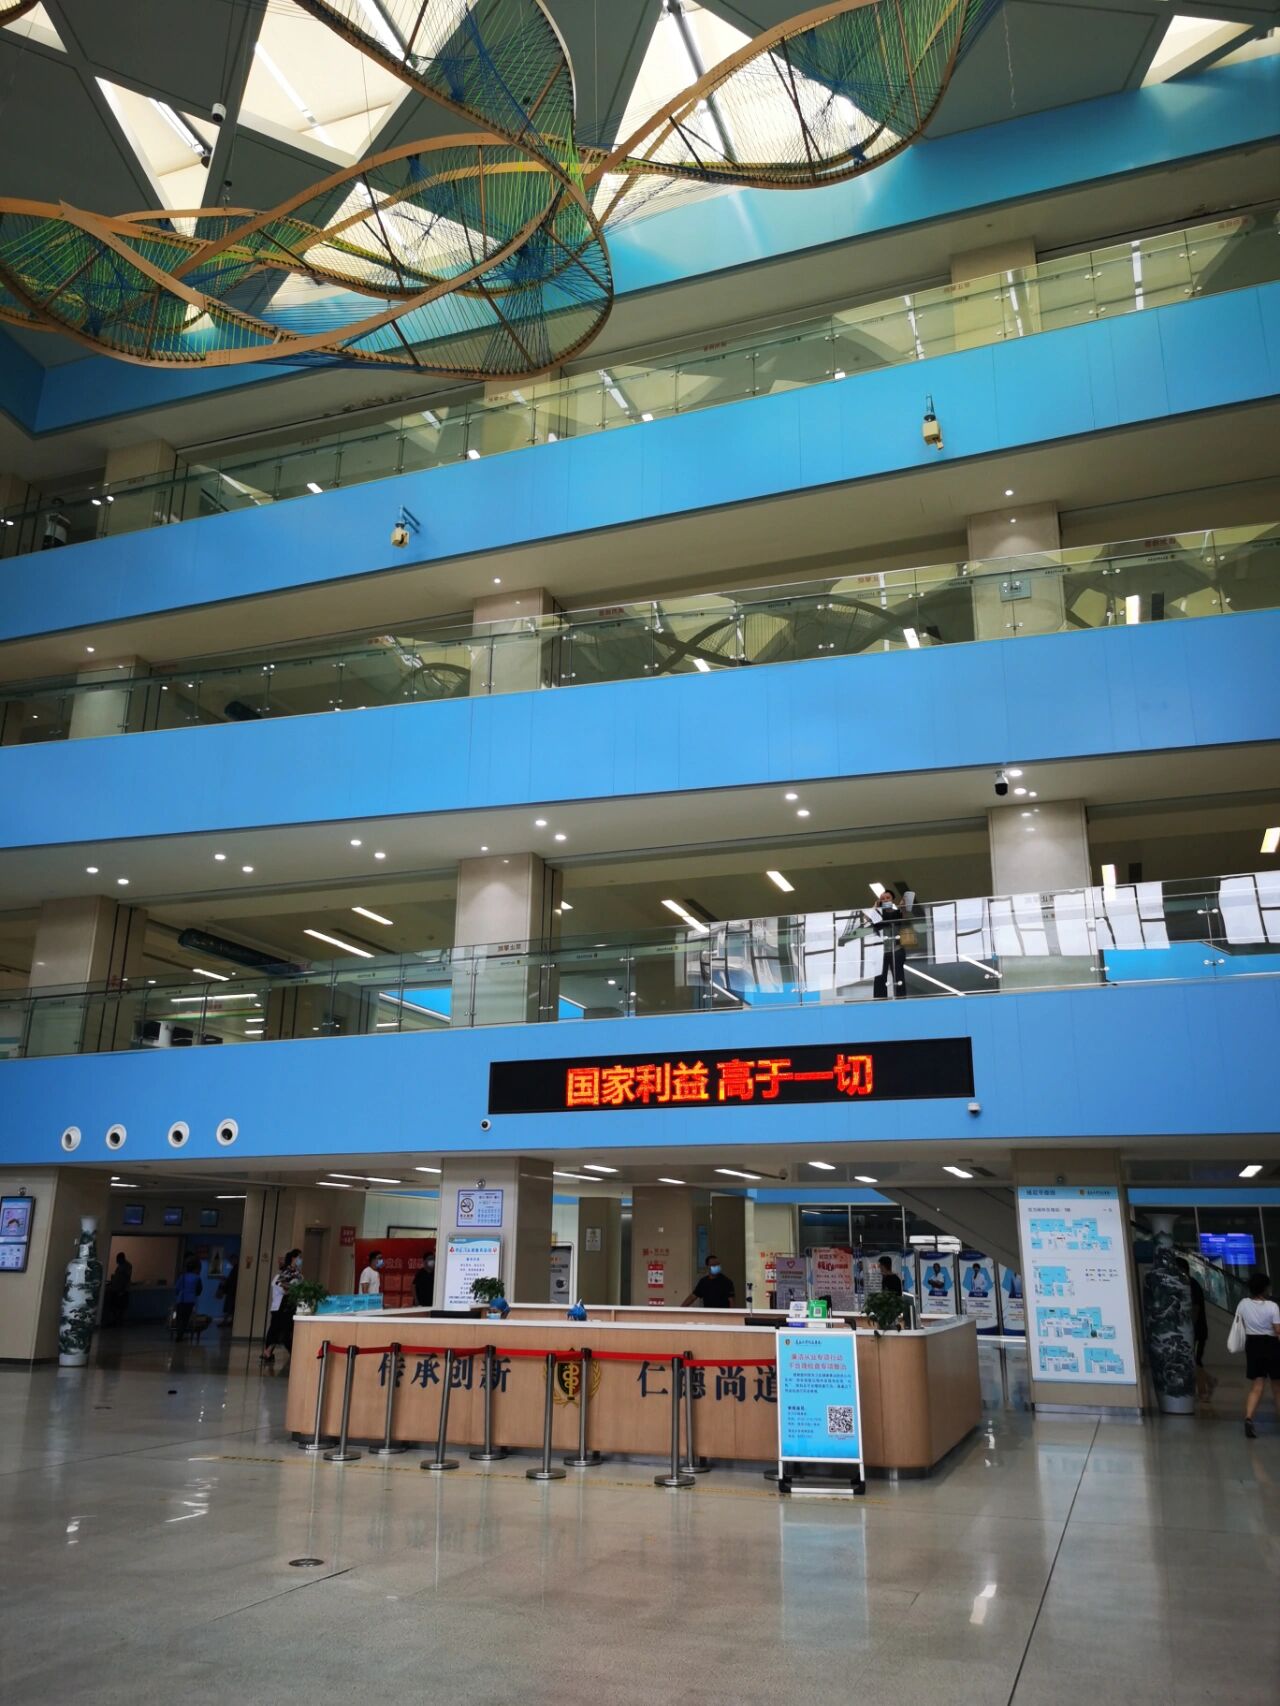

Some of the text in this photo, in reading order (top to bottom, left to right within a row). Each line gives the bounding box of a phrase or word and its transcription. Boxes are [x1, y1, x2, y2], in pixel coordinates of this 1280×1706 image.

[566, 1054, 874, 1106] 国家利益 高于一切
